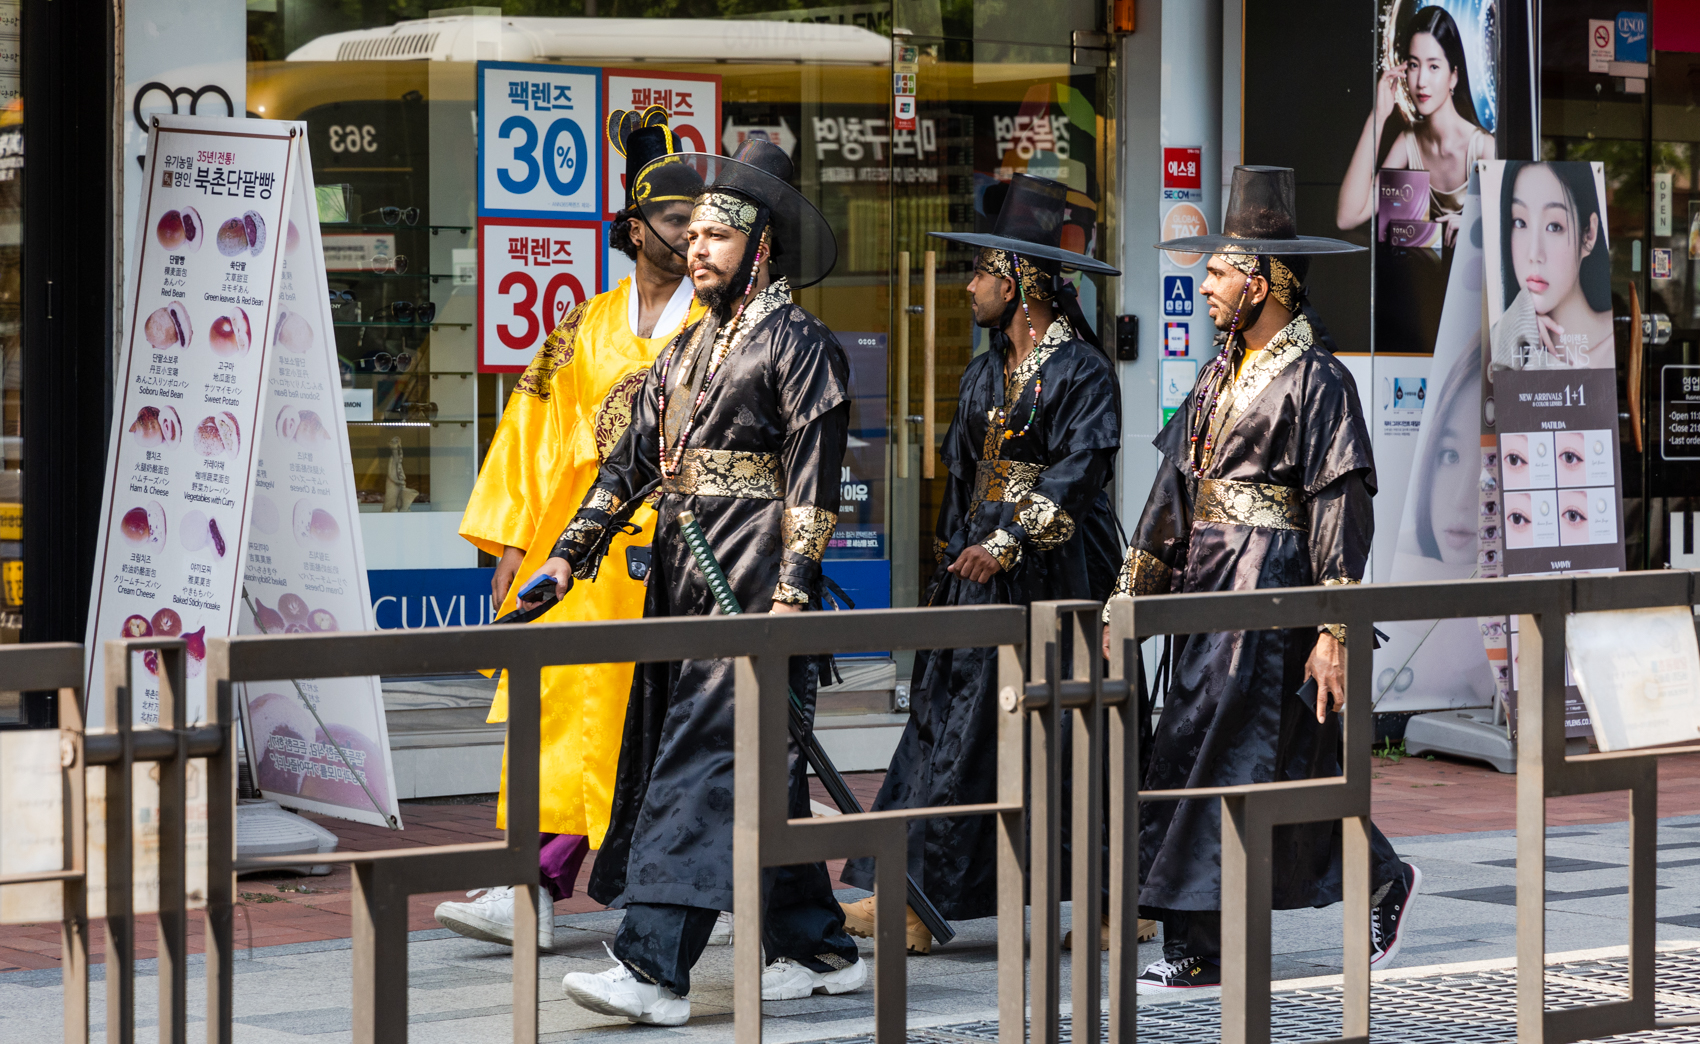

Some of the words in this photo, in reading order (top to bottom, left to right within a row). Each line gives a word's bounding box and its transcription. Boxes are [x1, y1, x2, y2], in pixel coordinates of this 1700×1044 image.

[1618, 18, 1645, 33] CESCO
[897, 80, 914, 88] JCB
[508, 81, 574, 111] 팩렌즈
[631, 88, 694, 117] 팩렌즈
[164, 155, 194, 170] 유기농밀
[196, 150, 217, 164] 35년!
[217, 152, 236, 165] 전통!
[1167, 160, 1196, 177] 에스원
[174, 171, 192, 188] 명인
[194, 167, 275, 200] 북촌단팥빵
[1164, 190, 1189, 200] SECOM
[1172, 215, 1200, 224] GLOBAL
[1171, 224, 1200, 238] TAX
[508, 236, 574, 266] 팩렌즈
[161, 288, 171, 297] Red
[172, 289, 186, 298] Bean
[1171, 278, 1186, 299] A
[204, 292, 219, 302] Green
[220, 294, 236, 304] leaves
[242, 297, 251, 305] Red
[252, 298, 264, 307] Bean
[1511, 344, 1590, 368] HEYLENS
[218, 361, 235, 372] 고구마
[139, 385, 159, 396] Soboru
[159, 388, 170, 397] Red
[170, 389, 184, 399] Bean
[1519, 393, 1533, 401] NEW
[1534, 392, 1562, 401] ARRIVALS
[1564, 384, 1586, 406] 1+1
[204, 394, 222, 405] Sweet
[222, 396, 240, 407] Potato
[1671, 423, 1689, 433] Close
[1671, 435, 1685, 445] Last
[203, 459, 225, 471] 카레야채
[129, 483, 142, 492] Ham
[149, 486, 170, 497] Cheese
[844, 484, 868, 501] 이유
[183, 491, 211, 502] Vegetables
[211, 496, 222, 505] with
[222, 497, 236, 509] Curry
[117, 585, 135, 596] Cream
[135, 588, 156, 600] Cheese
[371, 594, 499, 631] CUVU
